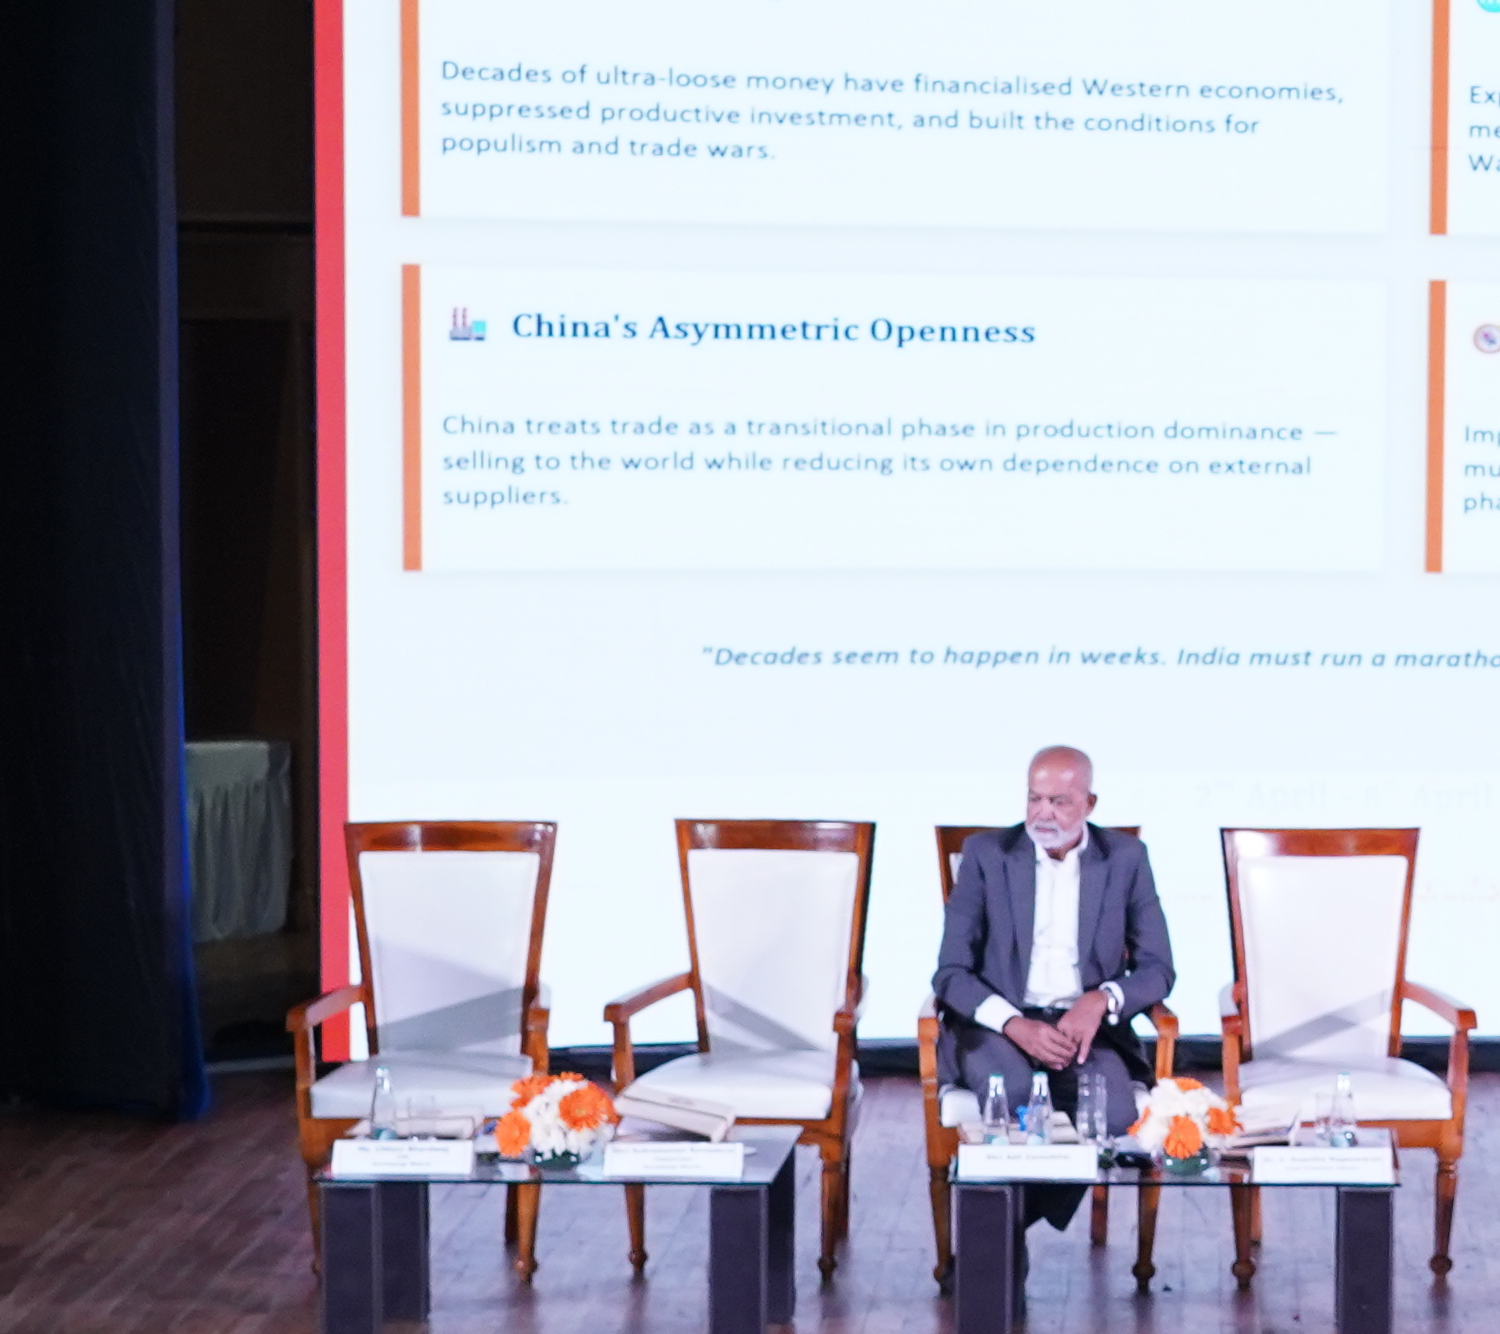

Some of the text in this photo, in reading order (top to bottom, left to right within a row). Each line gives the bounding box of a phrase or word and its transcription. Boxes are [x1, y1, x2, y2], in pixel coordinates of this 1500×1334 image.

[441, 59, 1344, 105] Decades of ultra-loose money have financialised Western economies,
[440, 99, 1260, 135] suppressed productive investment, and built the conditions for
[441, 132, 776, 160] populism and trade wars.
[512, 312, 1036, 349] China's Asymmetric Openness
[441, 414, 516, 435] China
[524, 418, 602, 436] treats
[609, 415, 680, 436] trade
[687, 421, 715, 436] as
[723, 421, 738, 436] a
[746, 416, 893, 437] transitional
[901, 417, 976, 441] phase
[985, 420, 1007, 437] in
[1015, 418, 1156, 442] production
[1163, 419, 1304, 442] dominance
[442, 449, 1312, 477] selling to the world while reducing its own dependence on external
[442, 484, 568, 510] suppliers.
[832, 650, 900, 666] seem
[909, 646, 936, 665] to
[942, 645, 1040, 669] happen
[1047, 646, 1072, 665] in
[1080, 645, 1166, 666] weeks.
[1176, 646, 1241, 667] India
[1248, 650, 1313, 667] must
[1320, 652, 1363, 667] run
[1370, 653, 1387, 668] a
